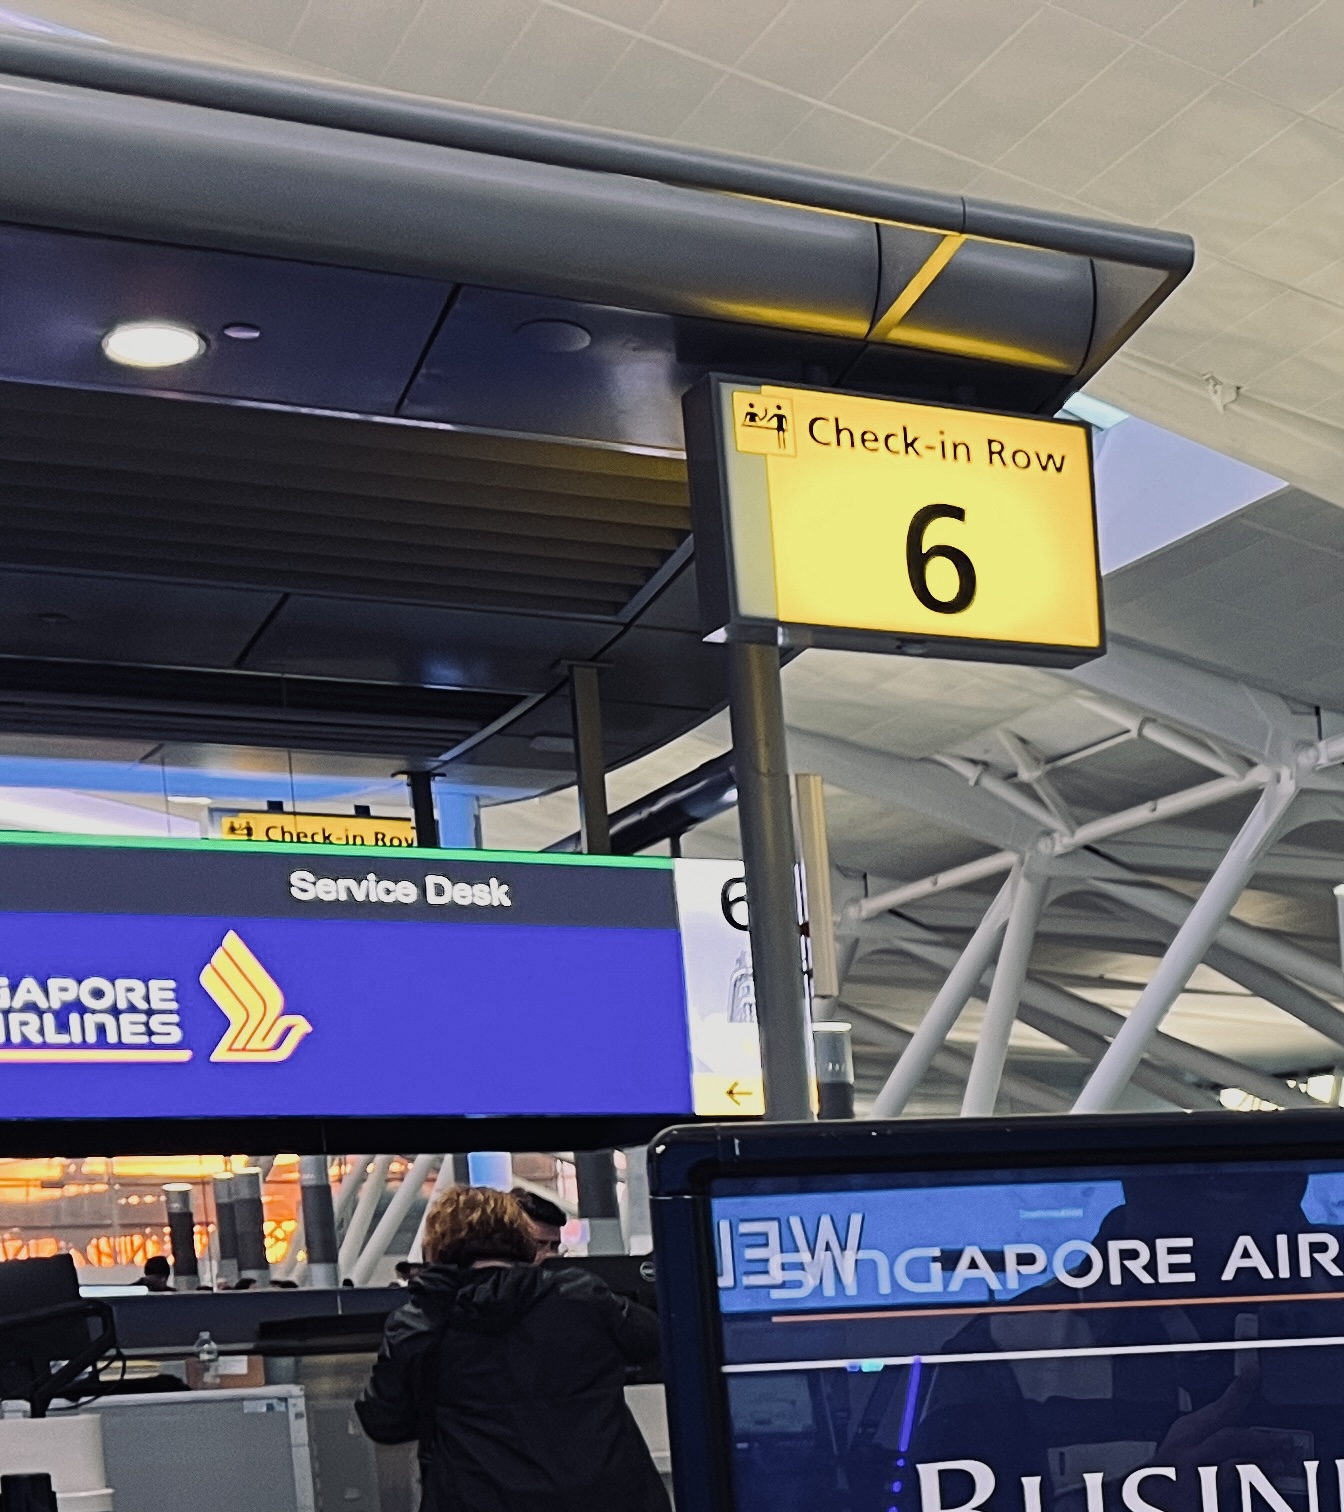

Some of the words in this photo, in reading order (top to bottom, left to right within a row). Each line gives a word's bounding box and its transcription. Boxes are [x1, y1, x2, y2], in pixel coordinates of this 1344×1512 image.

[808, 415, 972, 462] Check-in
[988, 437, 1065, 474] Row
[905, 503, 977, 614] 6
[264, 825, 364, 845] Check-in
[290, 870, 418, 904] Service
[425, 873, 512, 907] Desk
[769, 1237, 1197, 1300] SINGAPORE
